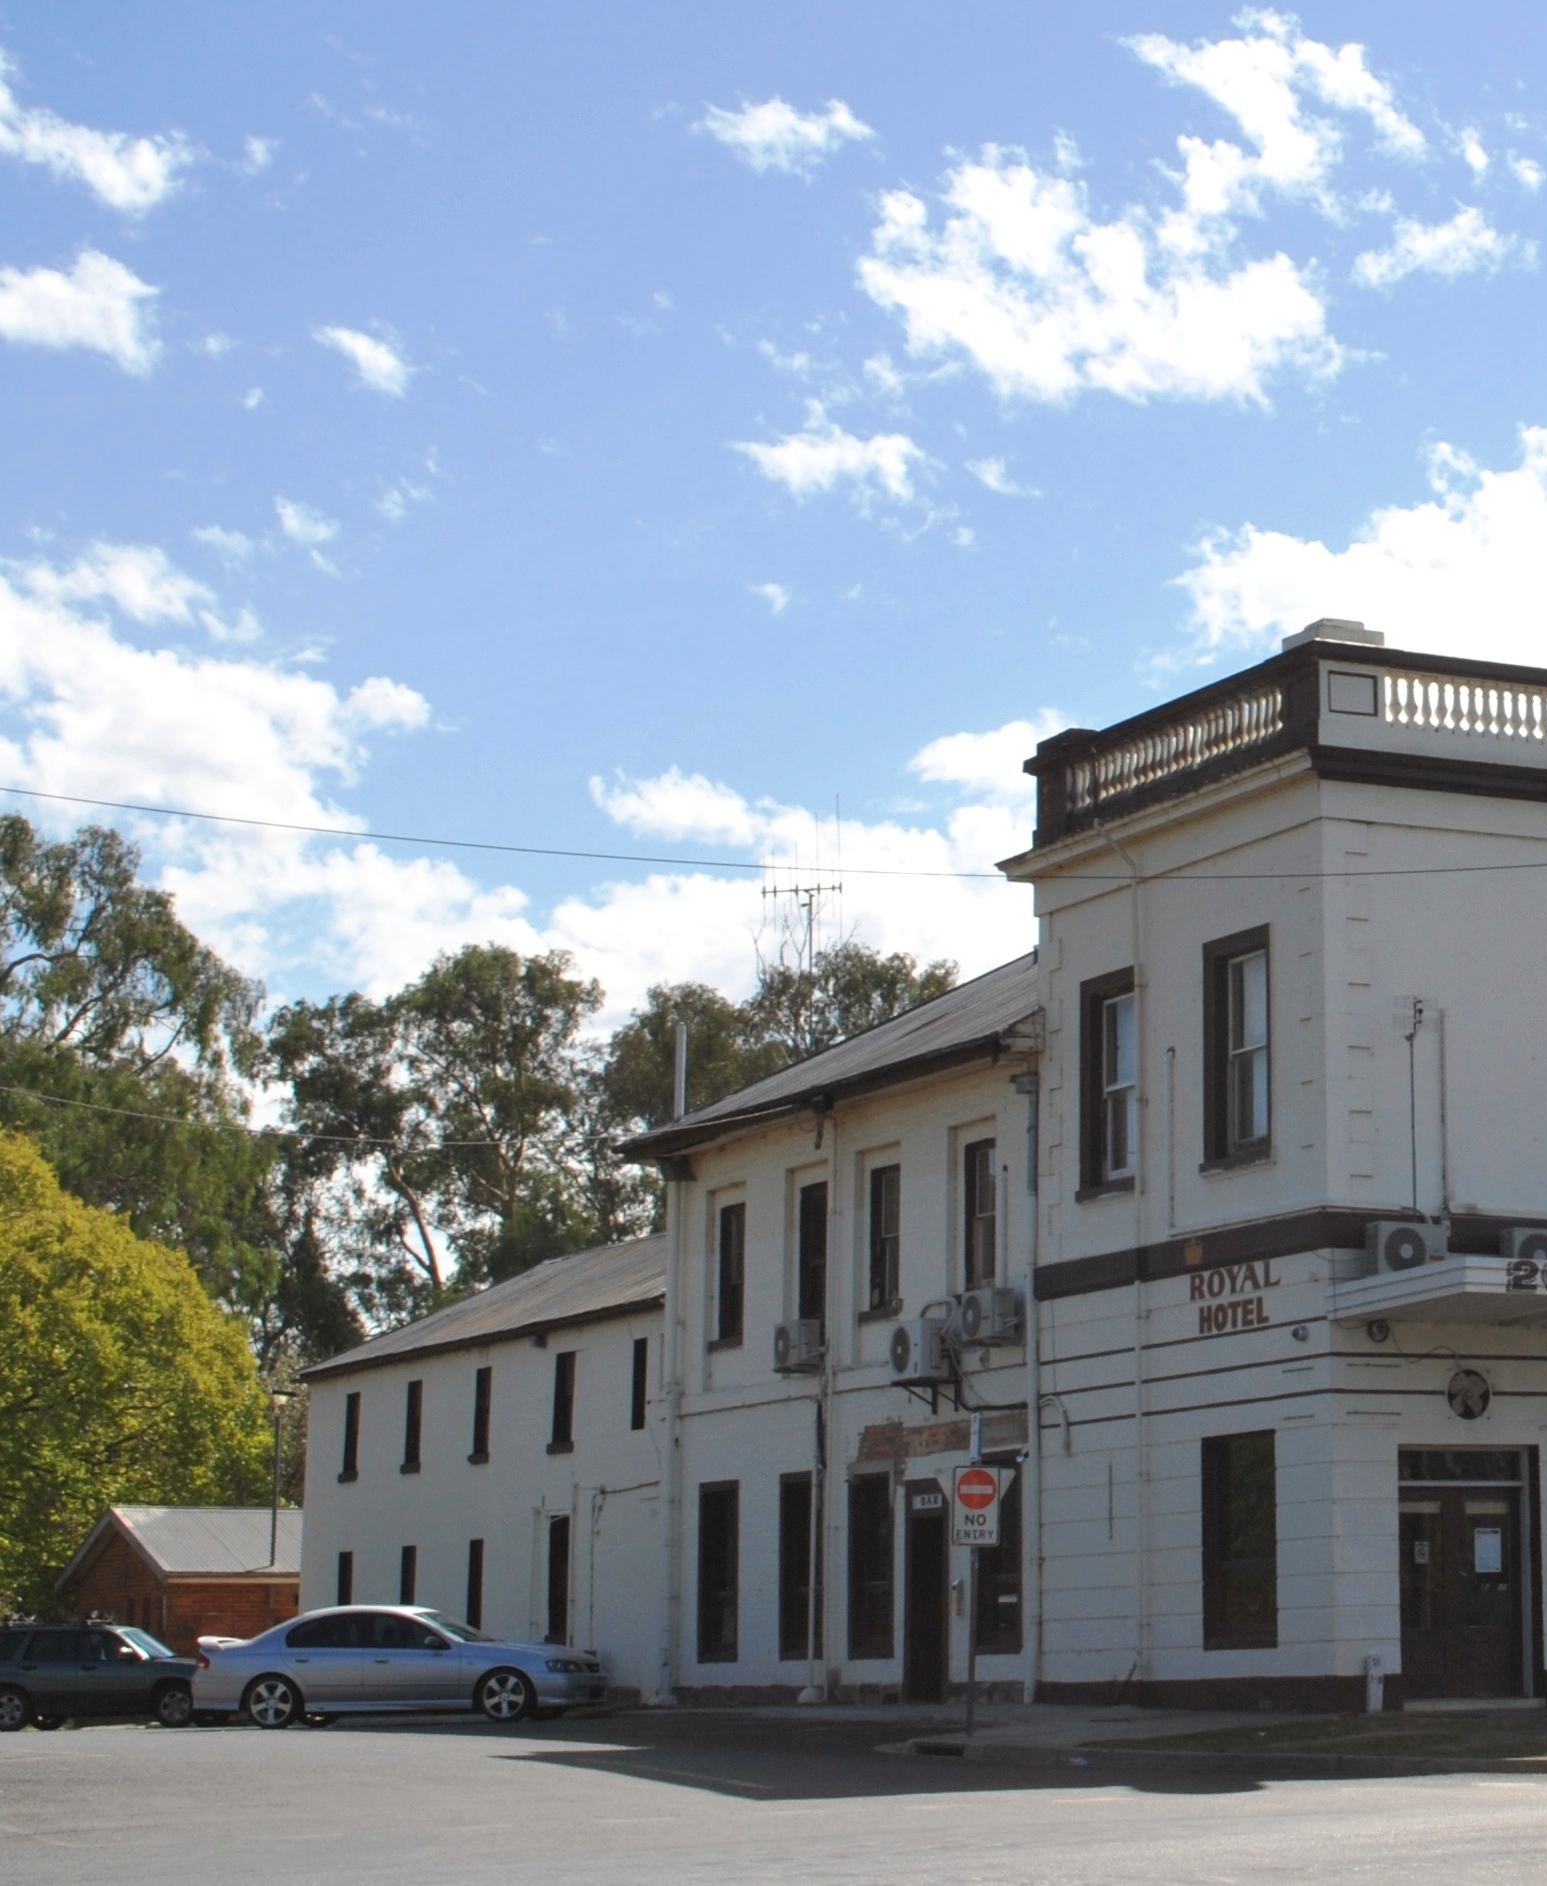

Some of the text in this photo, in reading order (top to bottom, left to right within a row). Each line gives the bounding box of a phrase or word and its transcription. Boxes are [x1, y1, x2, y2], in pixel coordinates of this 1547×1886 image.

[1190, 1259, 1281, 1301] ROYAL
[1199, 1296, 1270, 1334] HOTEL
[921, 1495, 940, 1506] BAR
[964, 1514, 987, 1526] NO
[956, 1529, 995, 1540] ENTRY
